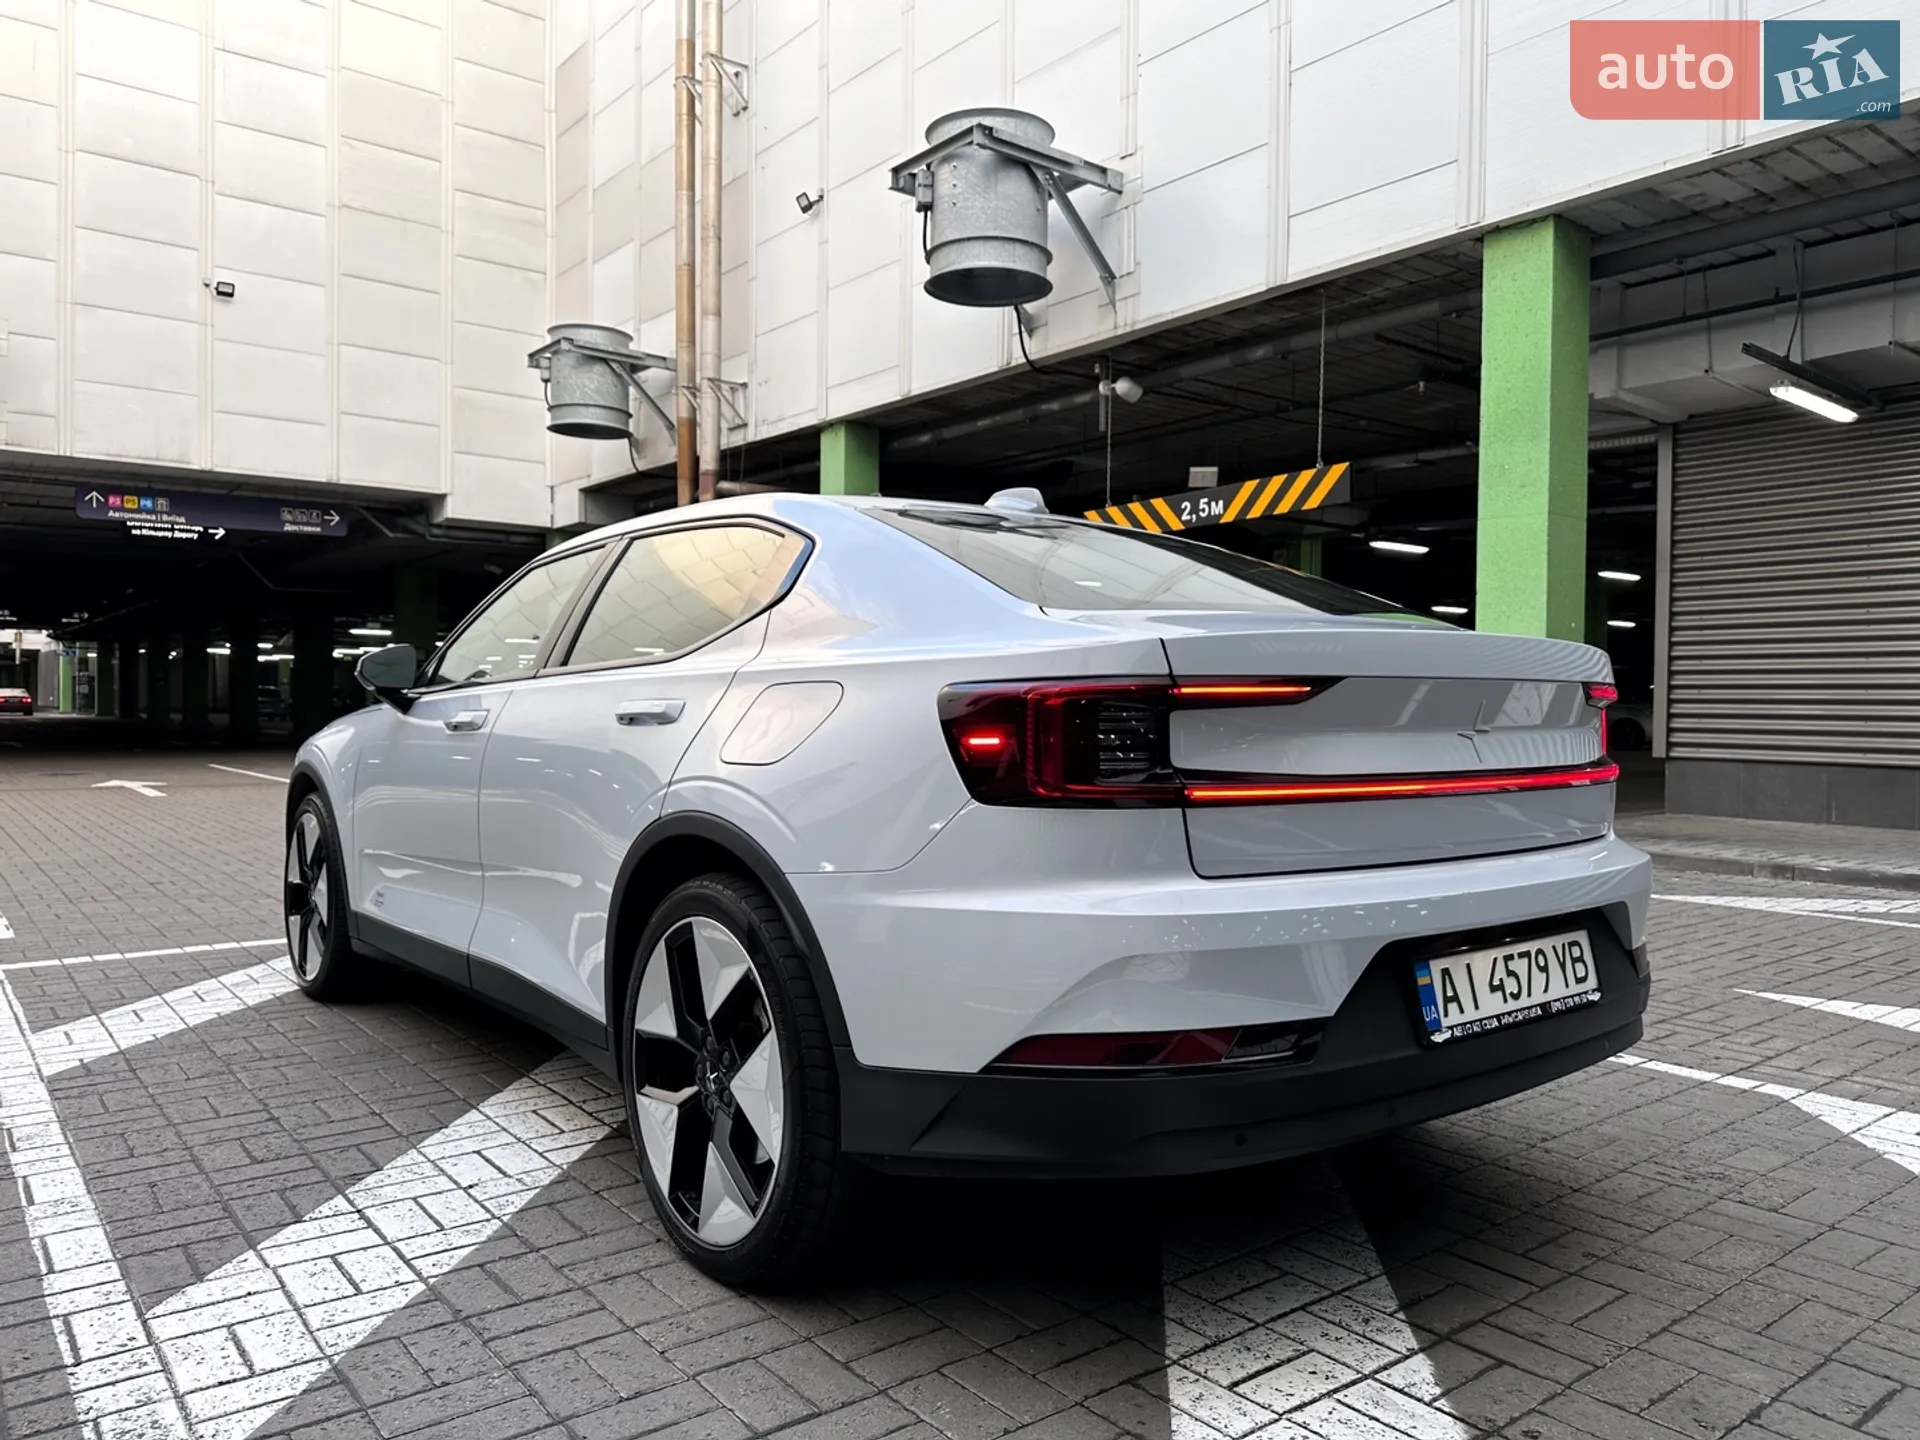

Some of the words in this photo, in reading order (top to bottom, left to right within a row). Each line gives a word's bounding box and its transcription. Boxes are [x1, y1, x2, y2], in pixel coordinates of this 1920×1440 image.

[109, 496, 121, 506] P3
[140, 498, 153, 508] P6
[1440, 962, 1479, 1018] AI
[1488, 947, 1550, 1004] 4579
[1552, 940, 1589, 989] YB
[1422, 1005, 1439, 1021] UA
